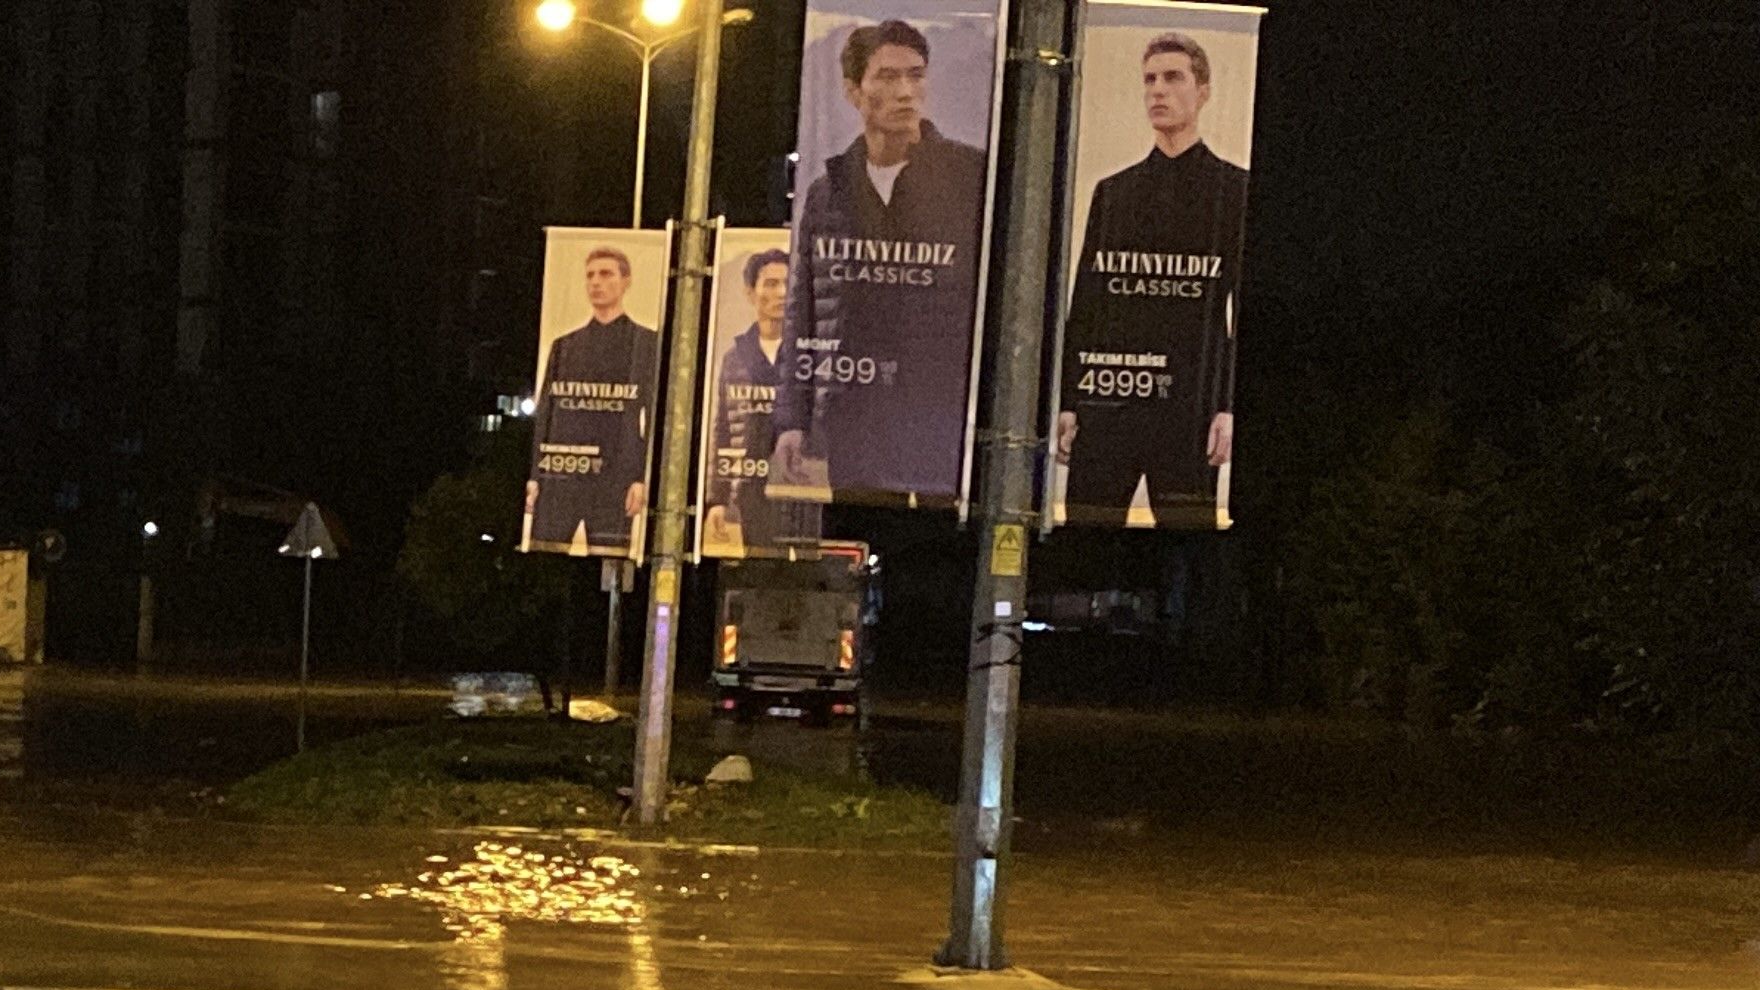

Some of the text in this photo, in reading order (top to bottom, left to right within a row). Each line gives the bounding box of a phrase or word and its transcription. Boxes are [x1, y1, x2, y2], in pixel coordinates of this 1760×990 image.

[814, 236, 957, 266] ALTINYILDIZ
[829, 263, 934, 286] CLASSICS
[1091, 250, 1223, 278] ALTINYILDIZ
[1107, 277, 1203, 298] CLASSICS
[795, 337, 841, 352] MONT
[794, 353, 877, 385] 3499
[1078, 352, 1123, 366] TAKIM
[550, 381, 639, 400] ALTINYILDIZ
[1077, 368, 1154, 398] 4999
[559, 398, 625, 412] CLASSICS
[537, 454, 591, 475] 4999
[717, 458, 770, 478] 3499
